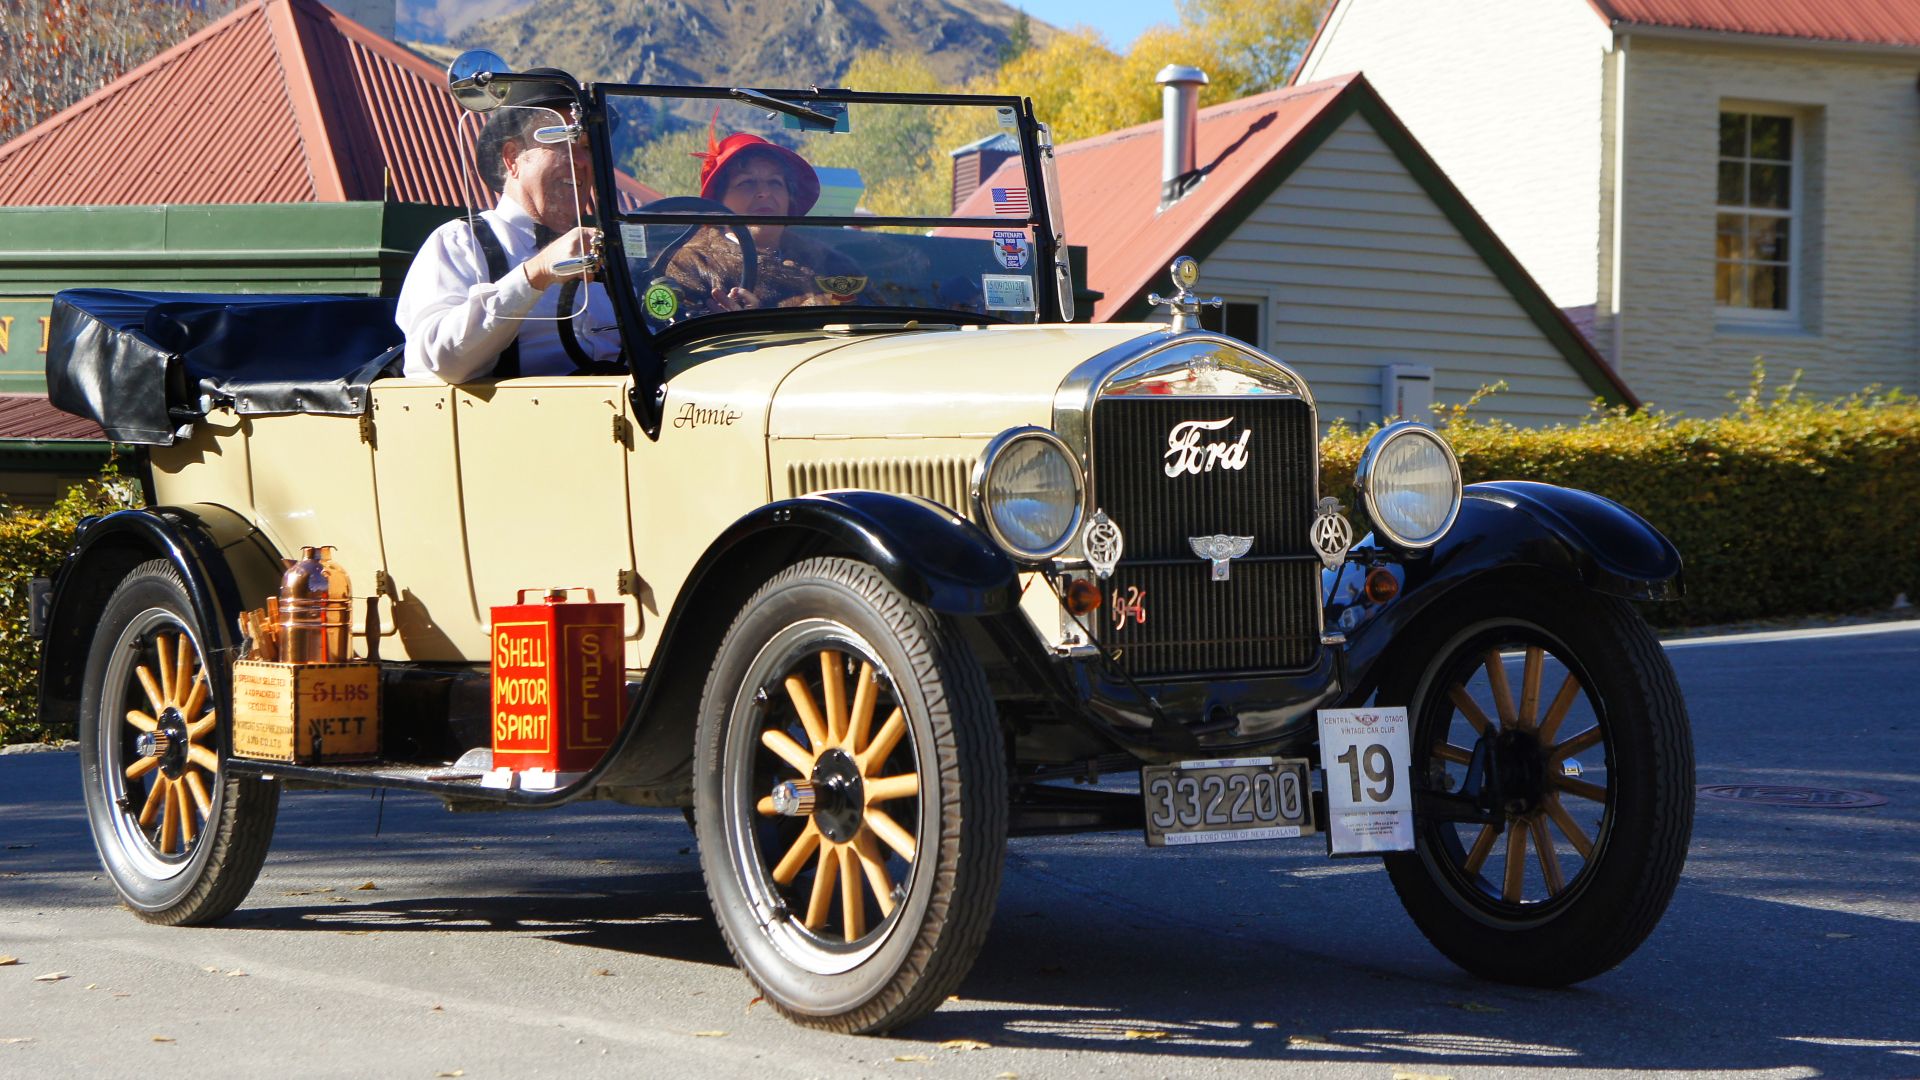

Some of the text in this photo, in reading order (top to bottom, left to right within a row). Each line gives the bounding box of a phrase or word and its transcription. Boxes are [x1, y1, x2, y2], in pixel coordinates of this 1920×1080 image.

[673, 402, 743, 429] Annie
[1164, 416, 1251, 478] Ford
[1112, 586, 1146, 630] 1926
[498, 632, 546, 669] SHELL
[496, 676, 548, 705] MOTOR
[582, 634, 602, 742] SHELL
[308, 718, 367, 736] NETT
[497, 711, 547, 741] SPIRIT
[1324, 715, 1404, 725] CENTRAL OTAGO
[1341, 727, 1366, 735] VINTAGE
[1380, 726, 1396, 734] CLUB
[1338, 743, 1395, 803] 19
[1151, 772, 1301, 827] 332200
[1167, 835, 1191, 845] MODEL
[1200, 832, 1219, 842] FORD
[1219, 830, 1239, 840] CLUB
[1239, 830, 1249, 839] OF
[1250, 829, 1266, 839] NEW
[1266, 827, 1299, 838] ZEALAND
